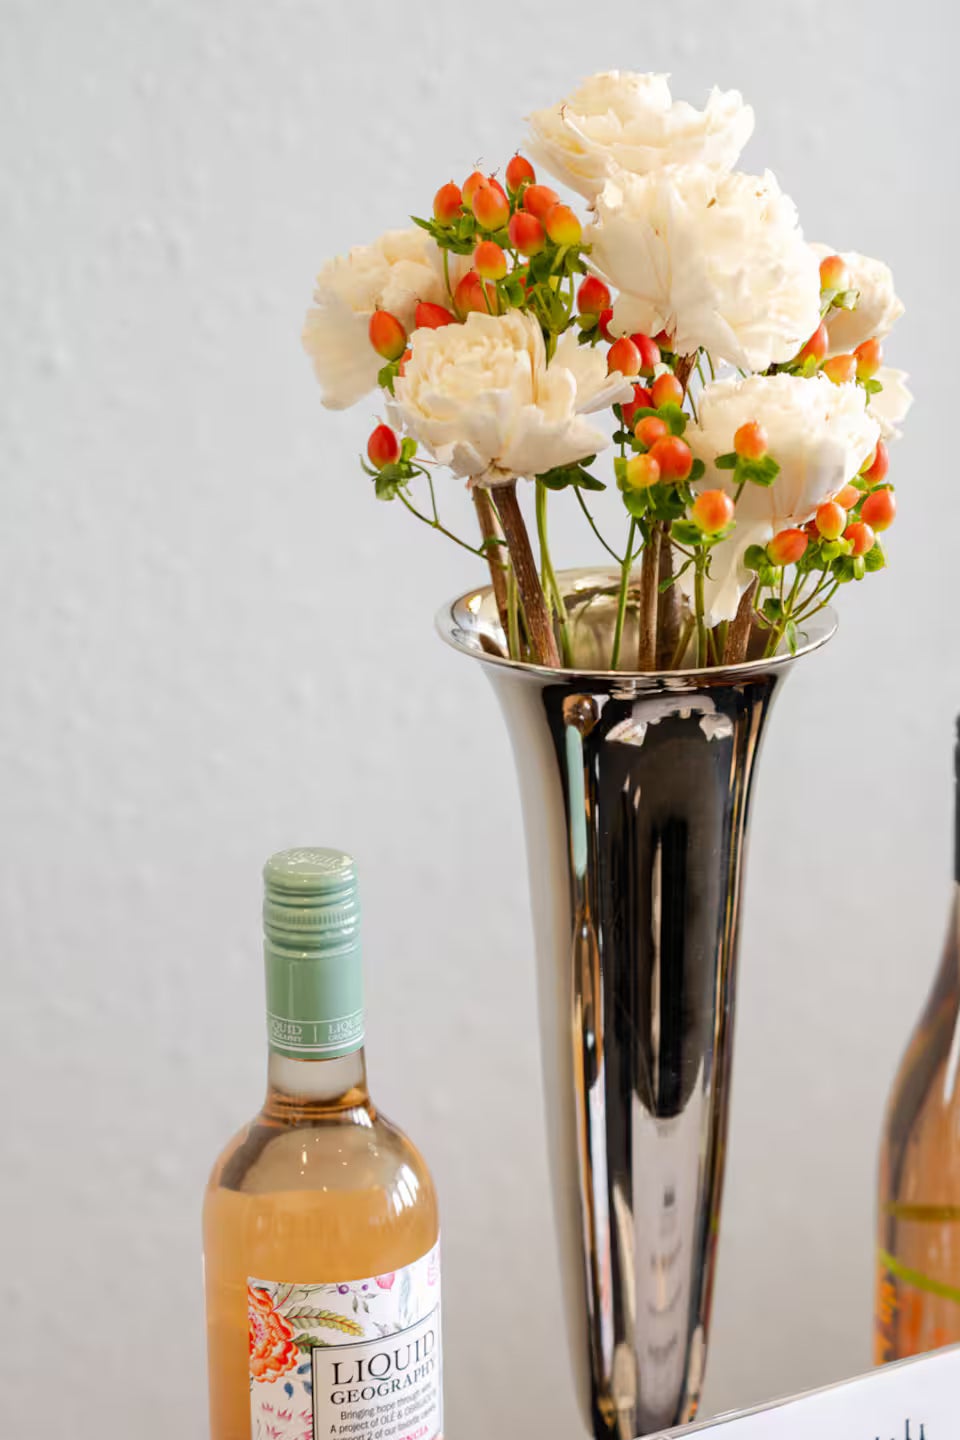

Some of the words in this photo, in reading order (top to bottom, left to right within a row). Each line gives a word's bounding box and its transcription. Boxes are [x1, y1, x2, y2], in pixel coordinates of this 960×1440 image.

[331, 1330, 435, 1386] LIQUID
[340, 1406, 375, 1421] Bringing
[330, 1424, 337, 1434] A
[339, 1420, 369, 1435] project
[370, 1417, 379, 1428] of
[367, 1432, 373, 1440] 2
[374, 1428, 383, 1438] of
